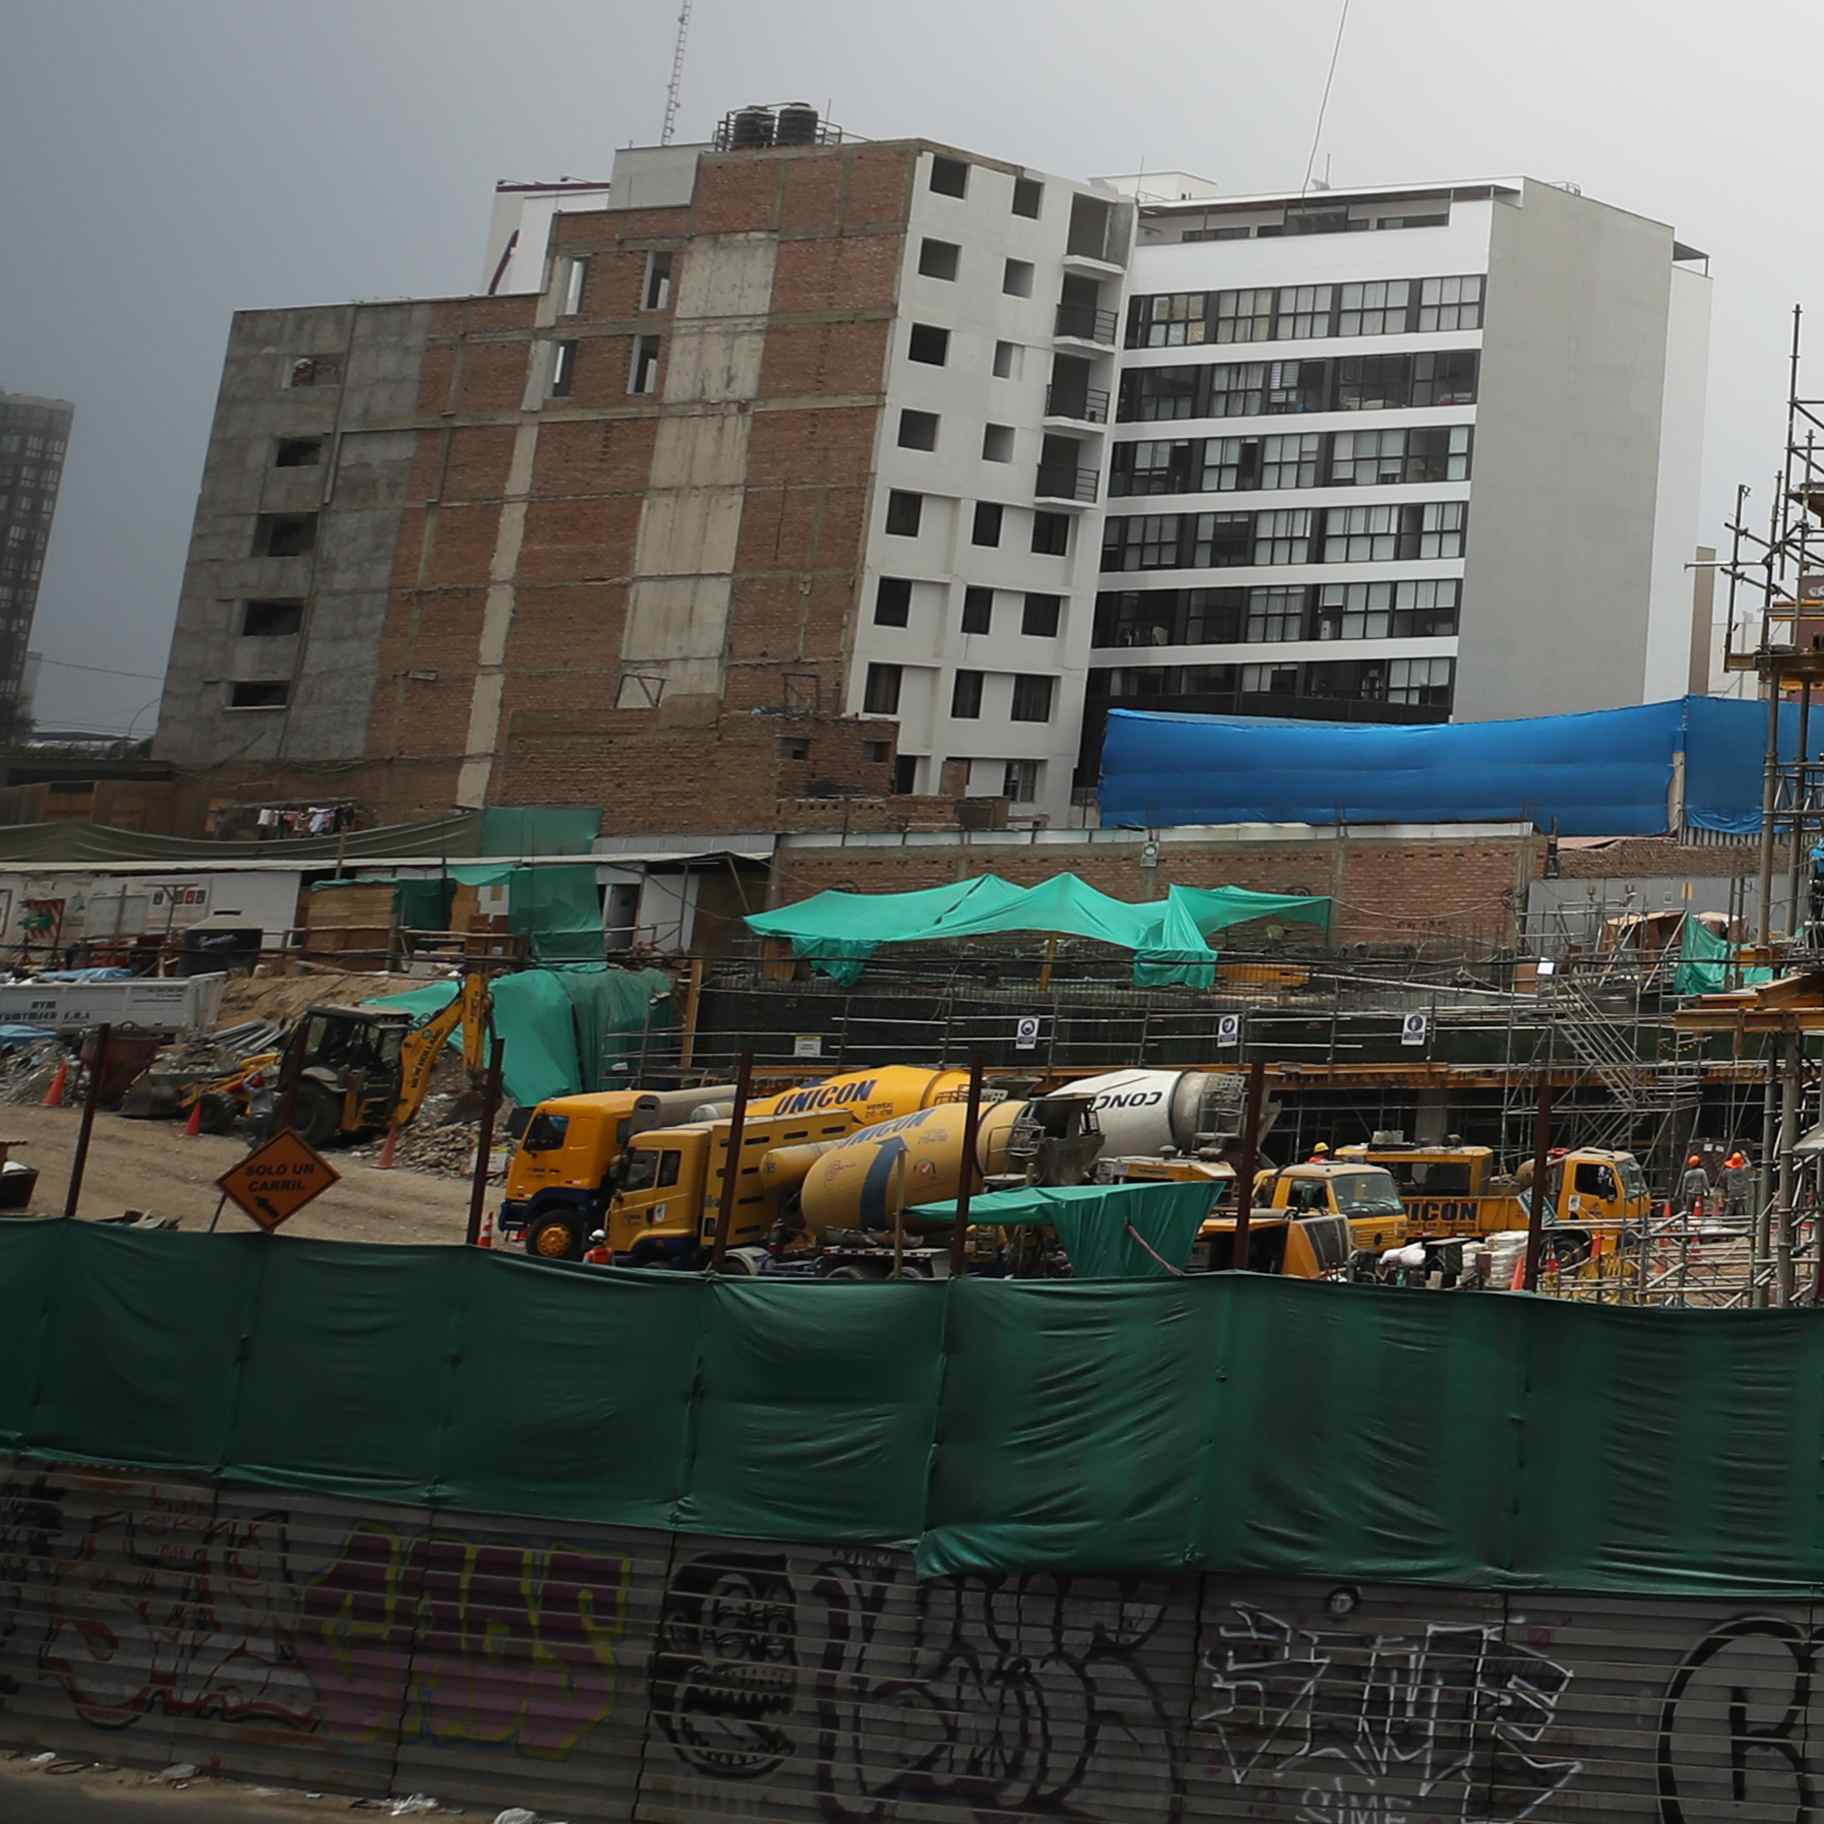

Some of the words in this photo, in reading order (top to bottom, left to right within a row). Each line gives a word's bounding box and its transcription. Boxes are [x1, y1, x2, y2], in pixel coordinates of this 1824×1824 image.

[774, 1079, 876, 1116] UNICON
[246, 1163, 287, 1176] SOLO
[292, 1163, 314, 1175] UN
[248, 1179, 304, 1192] CARRIL
